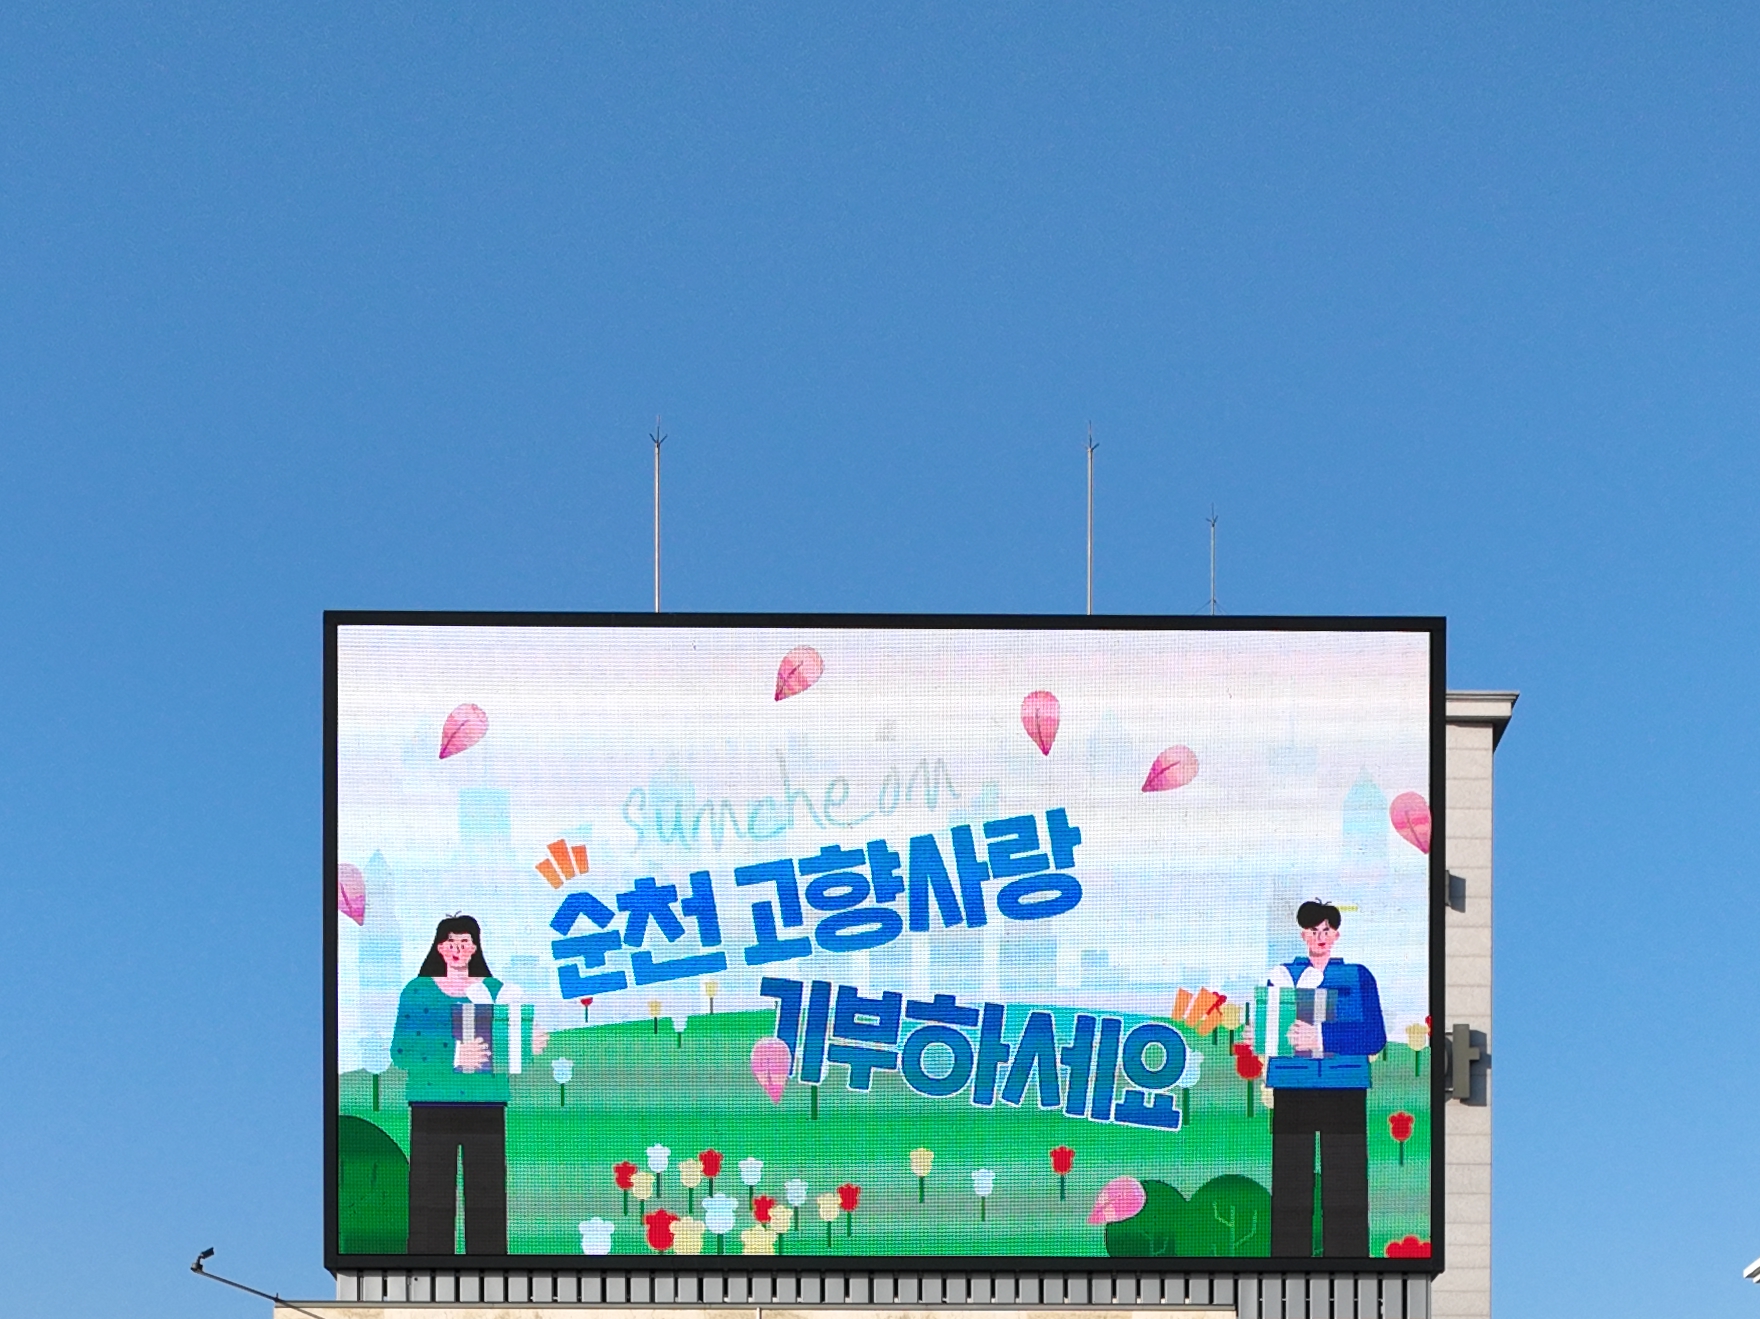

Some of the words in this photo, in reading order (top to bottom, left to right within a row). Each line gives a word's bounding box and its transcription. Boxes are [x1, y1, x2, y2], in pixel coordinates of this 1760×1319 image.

[550, 870, 728, 999] 순천
[734, 808, 1084, 964] 고향사랑
[759, 976, 1188, 1130] 기부하세요
